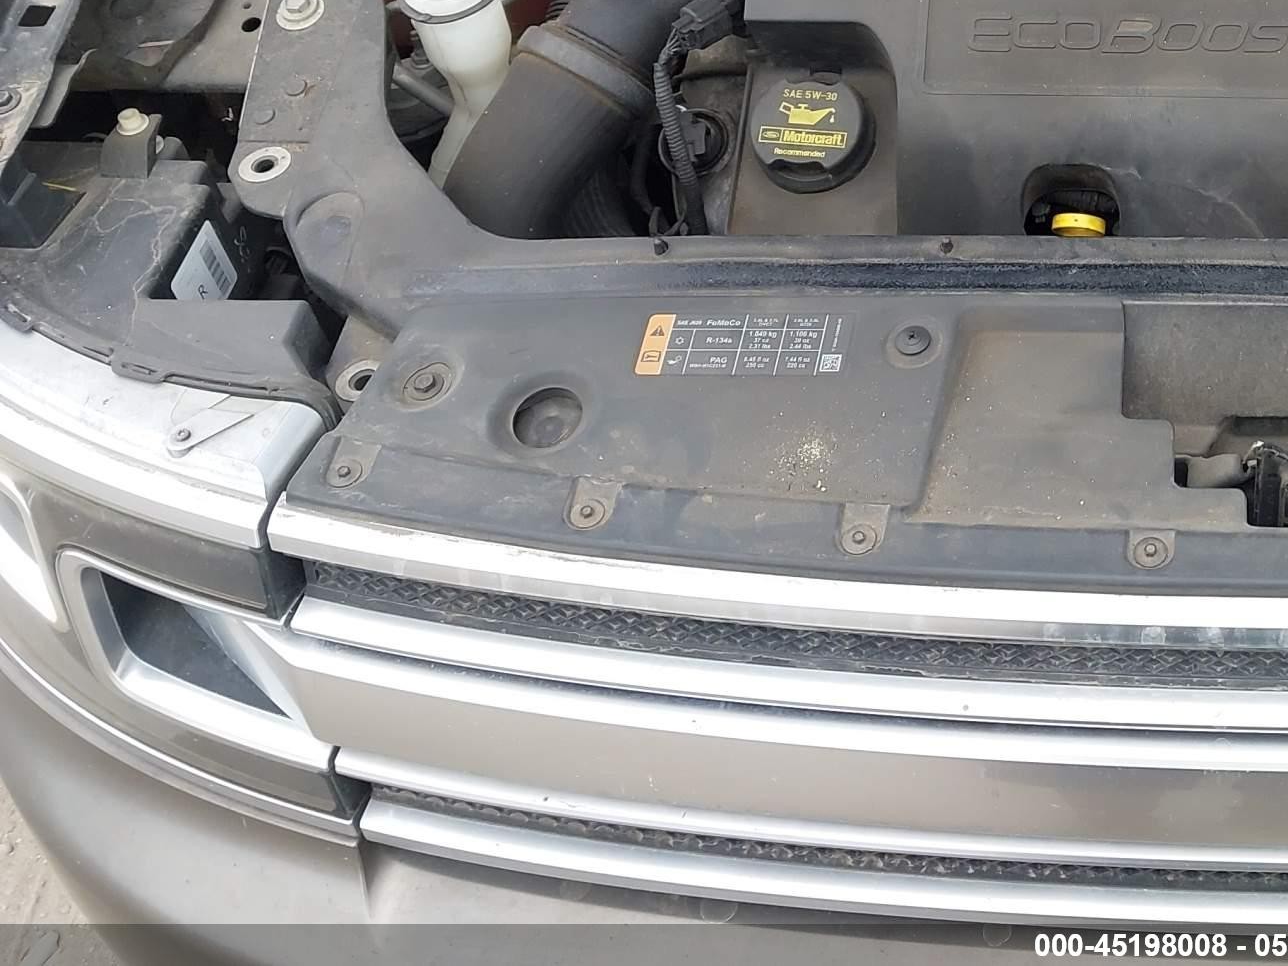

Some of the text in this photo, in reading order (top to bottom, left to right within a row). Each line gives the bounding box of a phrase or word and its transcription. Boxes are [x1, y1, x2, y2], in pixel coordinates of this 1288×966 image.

[783, 89, 838, 101] SAE 5W-30
[783, 130, 843, 146] Motorcraft
[773, 147, 826, 158] Recommended
[709, 356, 728, 364] PAG
